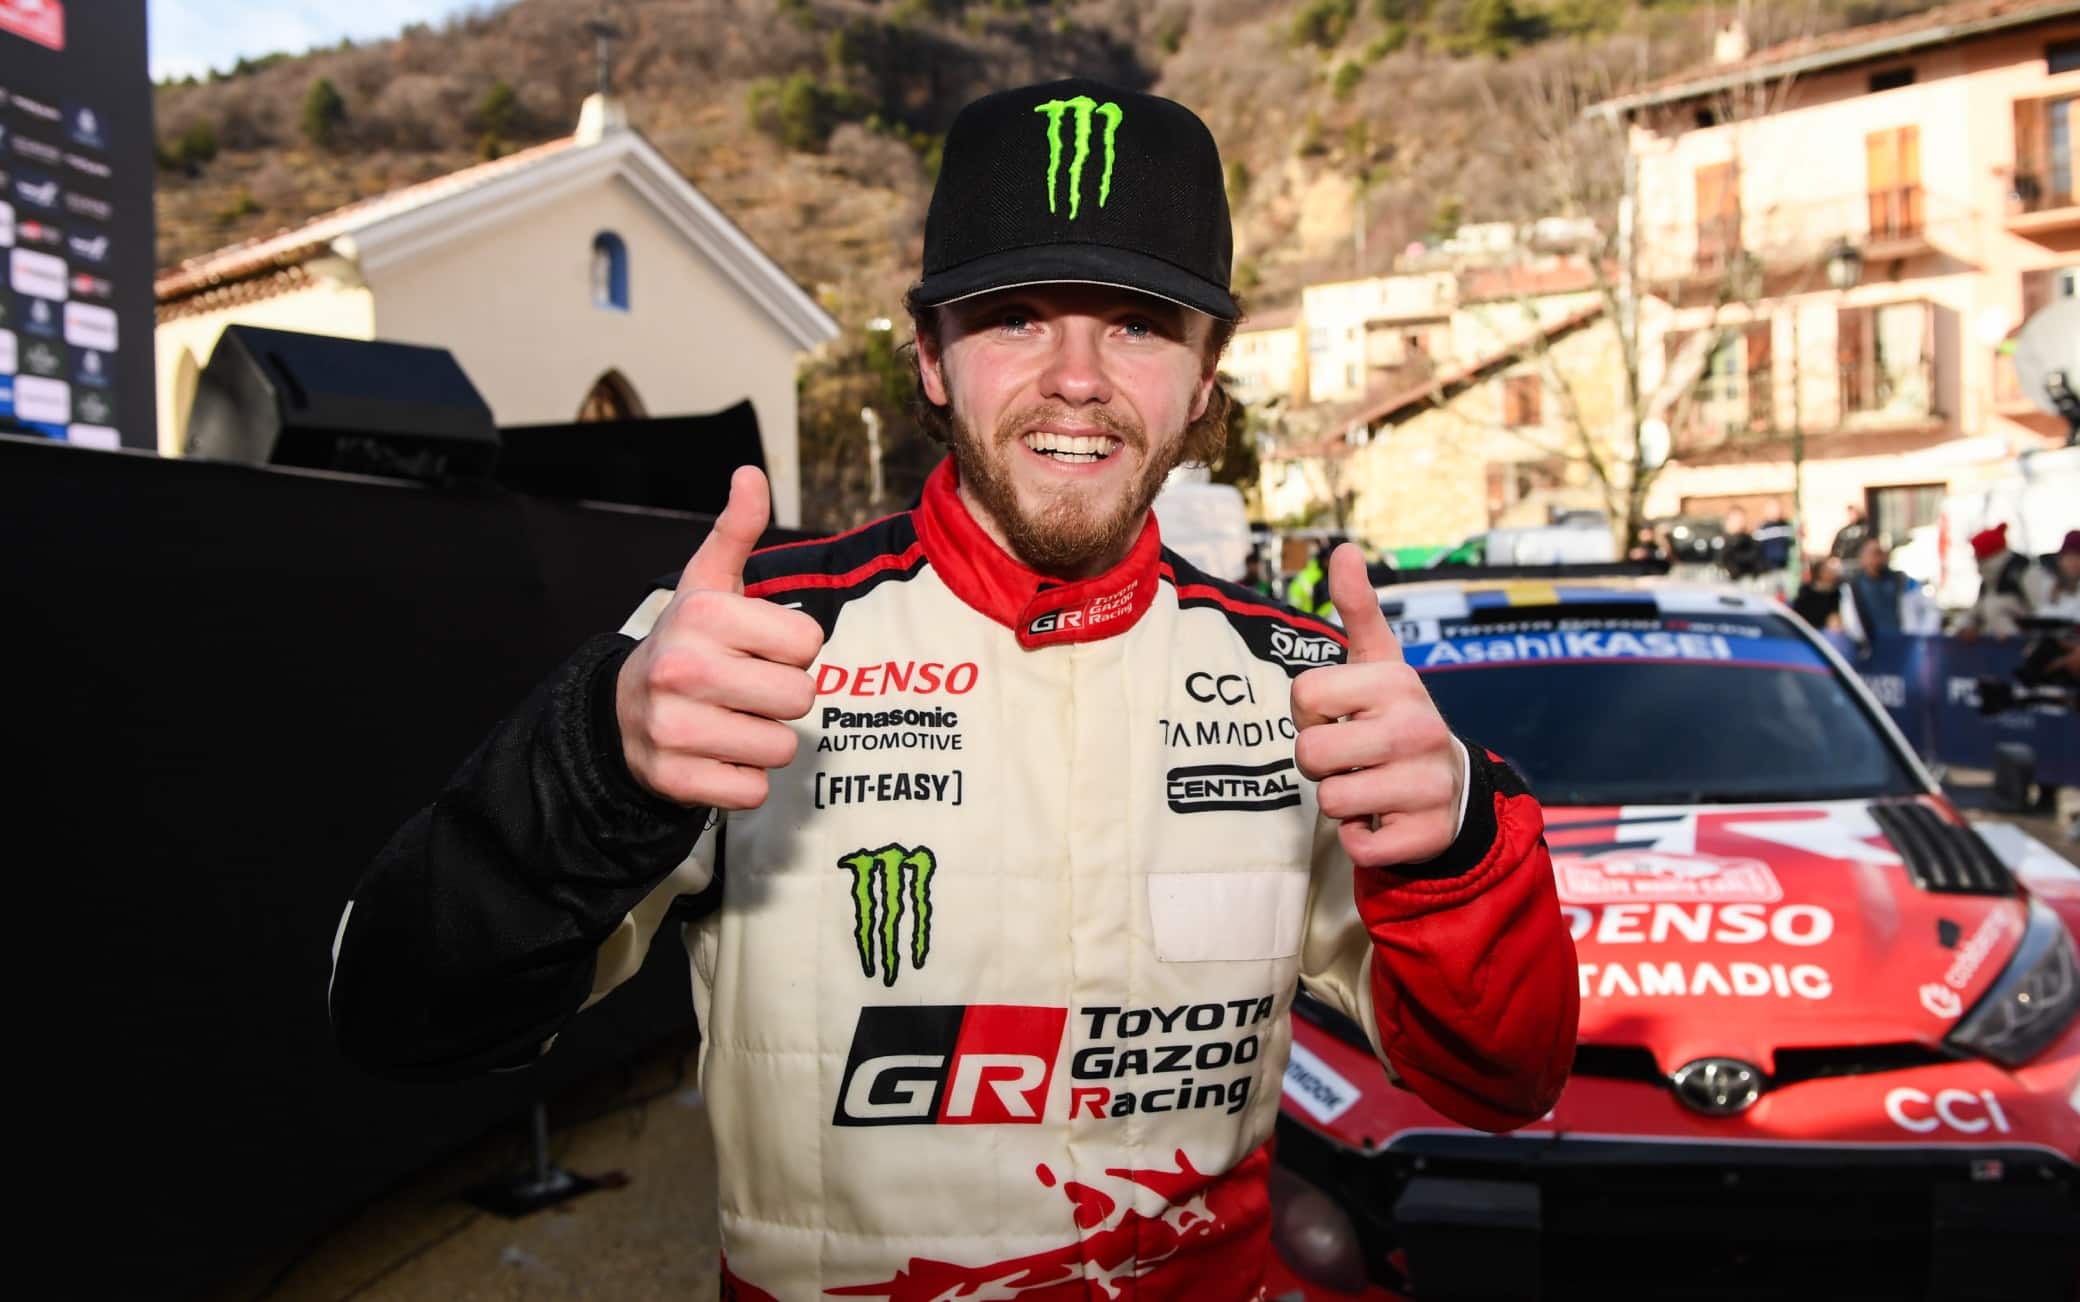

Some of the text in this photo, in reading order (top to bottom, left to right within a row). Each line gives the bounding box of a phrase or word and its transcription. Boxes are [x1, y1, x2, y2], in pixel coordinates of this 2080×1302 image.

[1088, 602, 1132, 625] Racing
[1089, 591, 1133, 615] GAZOO
[1030, 610, 1083, 633] GR
[1271, 628, 1341, 662] OMP
[815, 661, 979, 697] DENSO
[822, 706, 958, 729] Panasonic
[1159, 717, 1295, 748] TAMADIC
[817, 731, 962, 752] AUTOMOTIVE
[1167, 774, 1299, 799] CENTRAL
[1579, 961, 1833, 1000] TAMADIC
[1080, 994, 1274, 1039] TOYOTA
[1071, 1034, 1259, 1080] GAZOO
[842, 1053, 1047, 1119] GR
[1068, 1076, 1252, 1121] Racing
